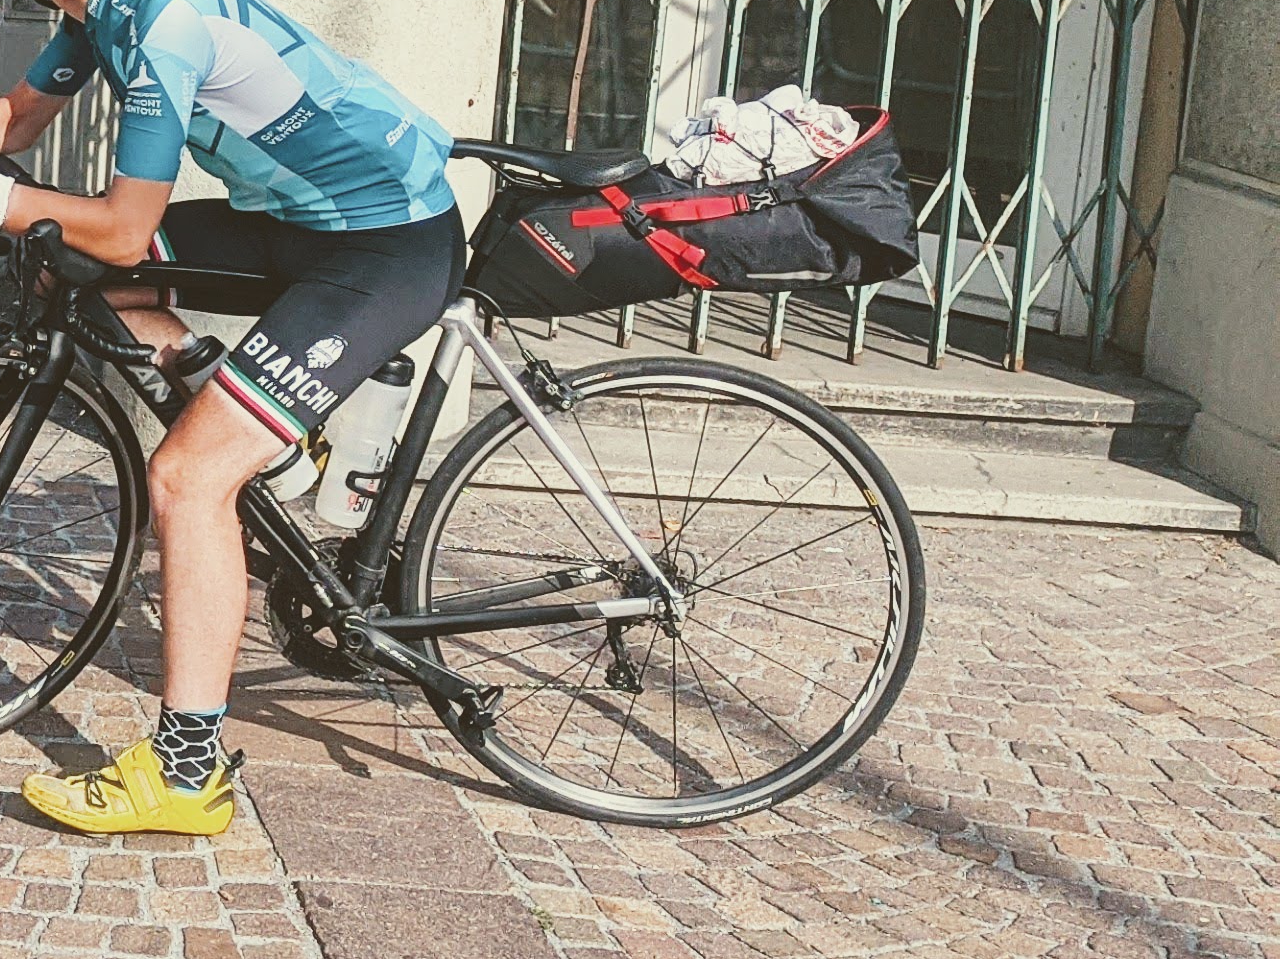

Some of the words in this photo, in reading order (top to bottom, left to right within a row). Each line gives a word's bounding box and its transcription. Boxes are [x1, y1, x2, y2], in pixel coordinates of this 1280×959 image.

[133, 97, 162, 109] MONT
[260, 127, 280, 144] GF
[276, 107, 310, 132] MONT
[267, 110, 316, 145] VENTOUX
[243, 331, 339, 415] BIANCHI
[255, 374, 295, 410] MILANO
